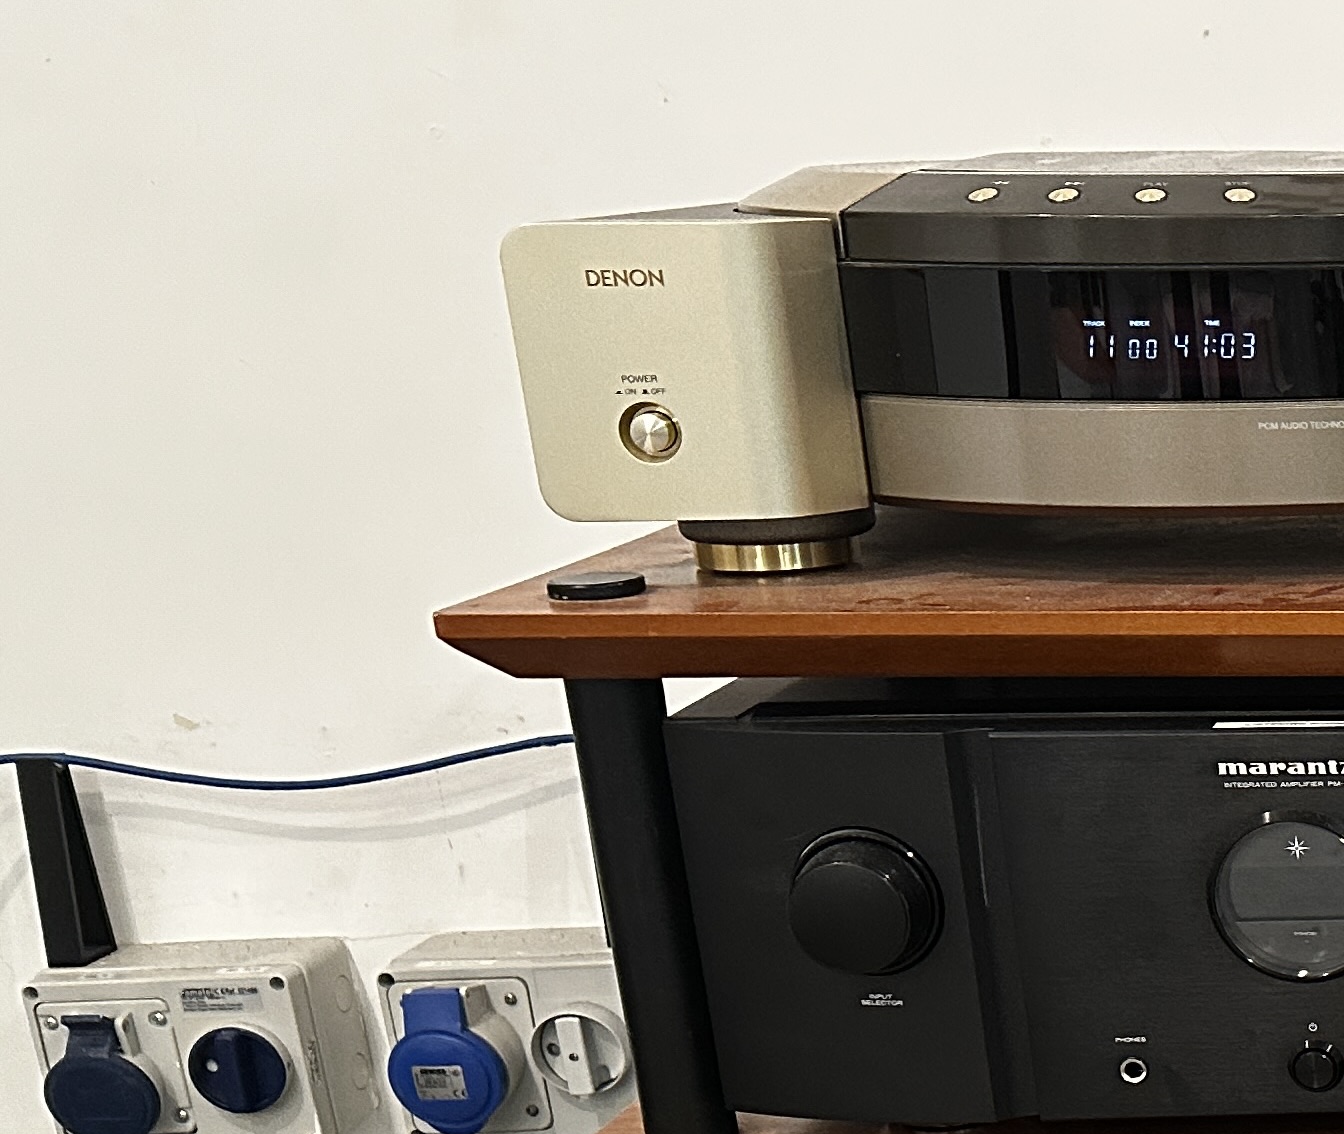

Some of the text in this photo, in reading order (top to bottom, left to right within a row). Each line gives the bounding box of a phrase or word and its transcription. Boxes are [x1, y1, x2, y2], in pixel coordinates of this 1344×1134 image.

[585, 269, 664, 287] DENON
[1128, 339, 1157, 359] 00
[621, 374, 657, 383] POWER
[1258, 422, 1279, 430] PCM
[1280, 421, 1308, 430] AUDIO
